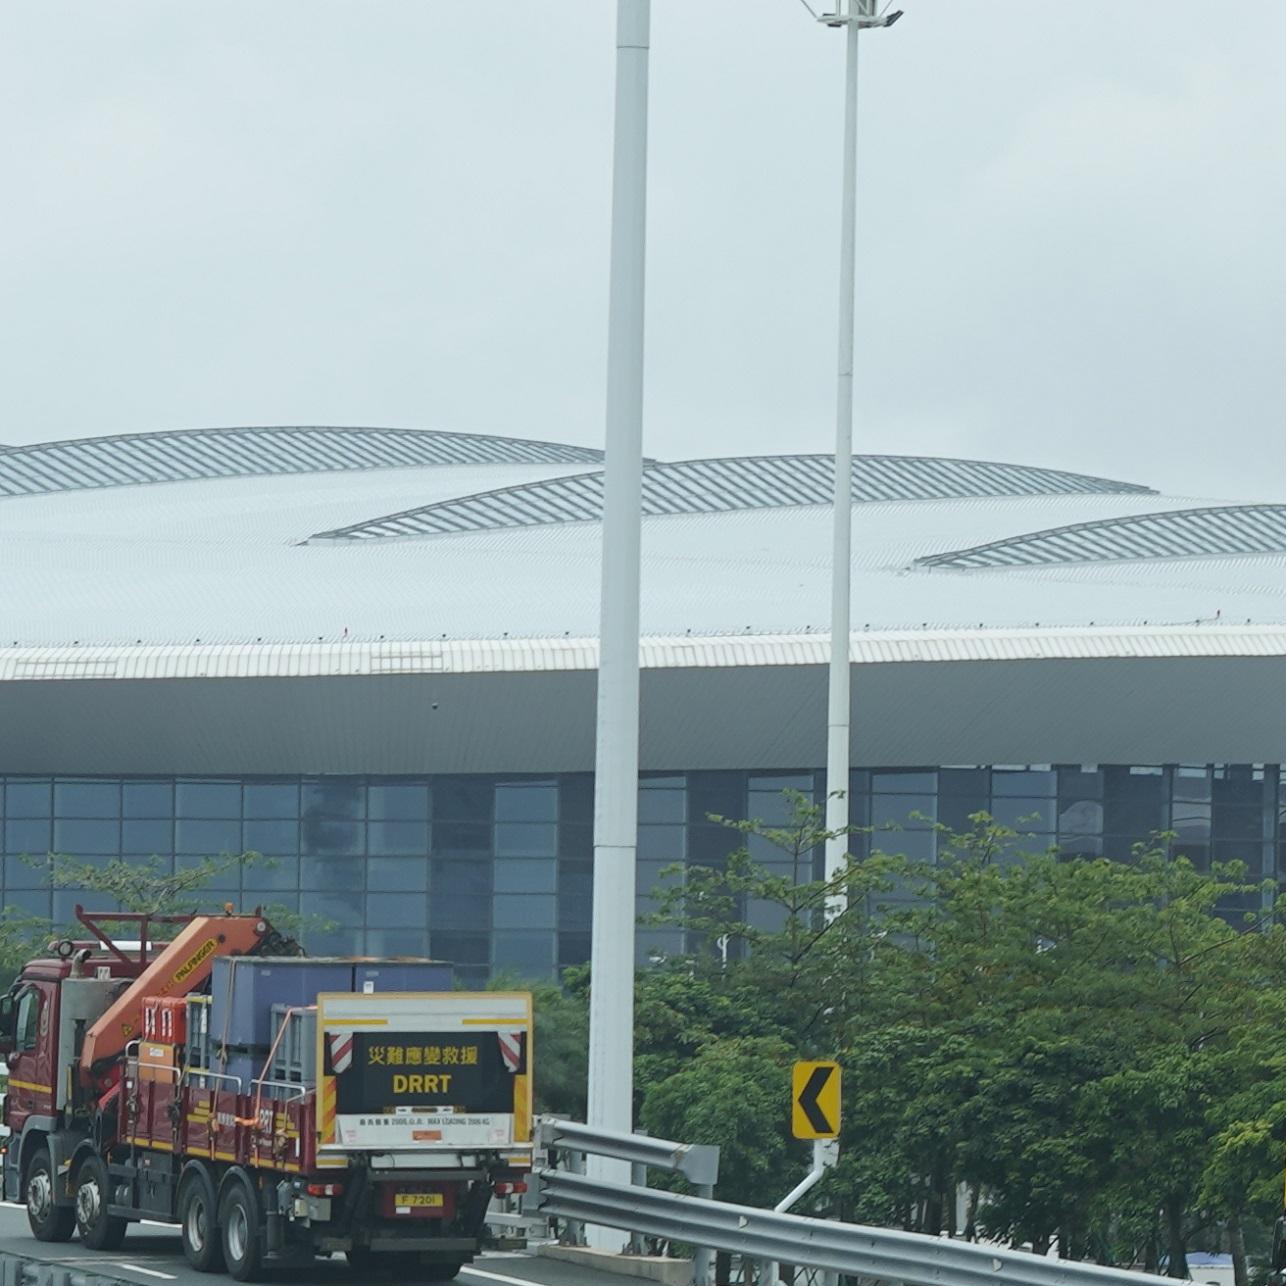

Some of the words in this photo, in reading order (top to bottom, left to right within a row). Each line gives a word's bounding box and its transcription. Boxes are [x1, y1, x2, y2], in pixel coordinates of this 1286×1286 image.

[175, 940, 215, 980] PALFINGER
[367, 1045, 479, 1066] 災難應變救援
[393, 1074, 452, 1094] DRRT
